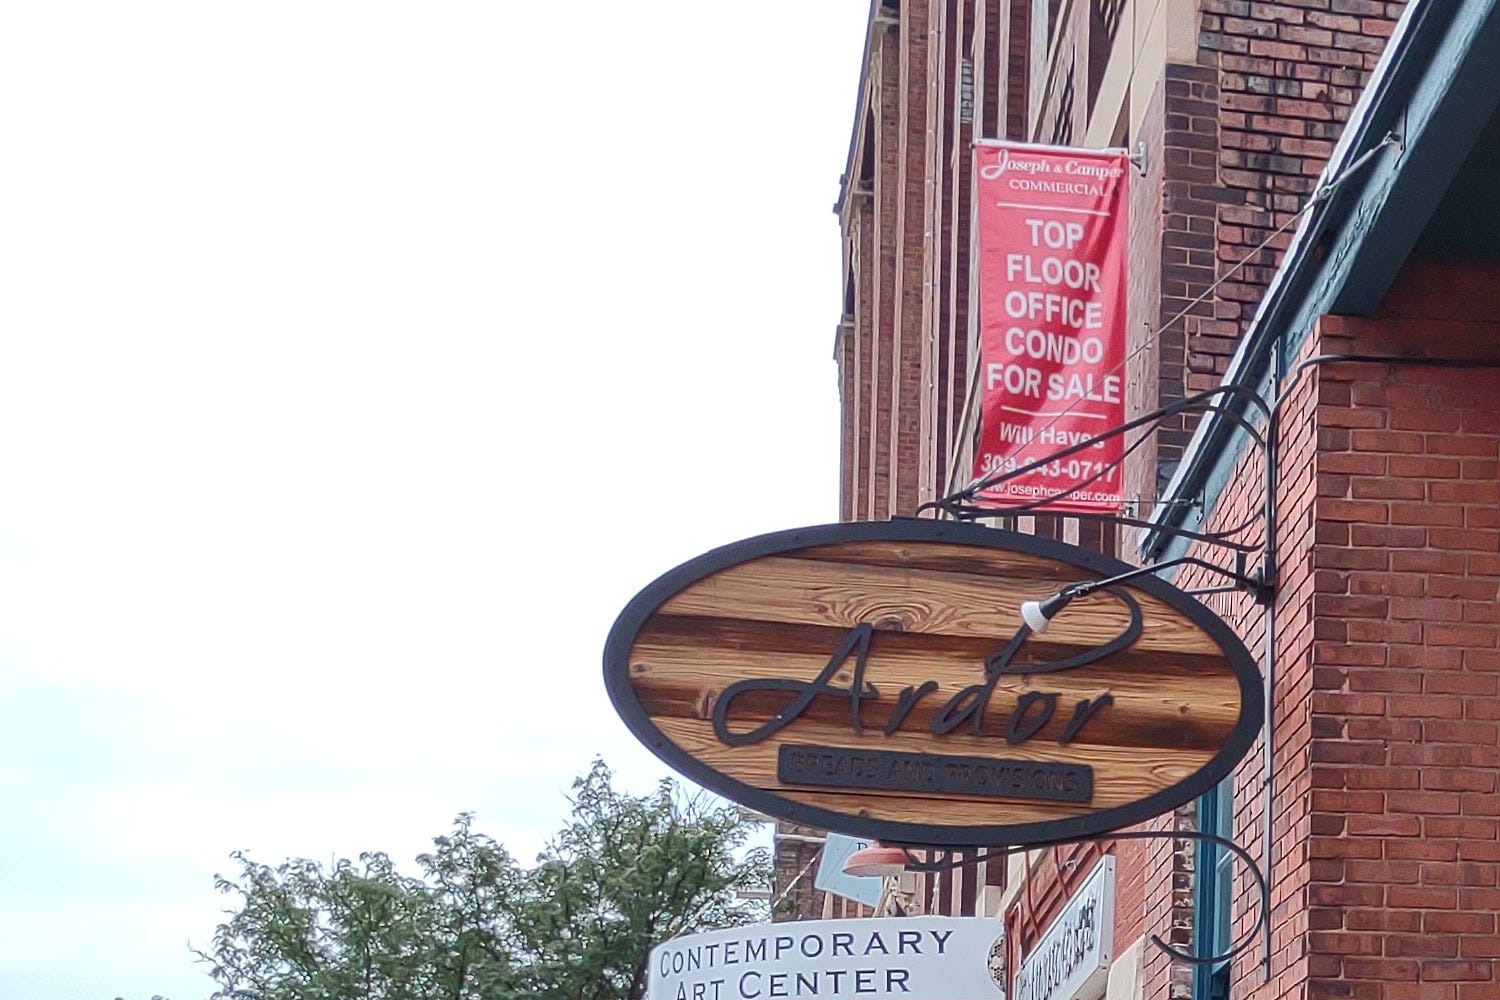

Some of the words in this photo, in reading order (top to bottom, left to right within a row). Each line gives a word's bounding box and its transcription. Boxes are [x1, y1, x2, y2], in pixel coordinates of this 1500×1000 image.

[981, 149, 1049, 179] Joseph
[1053, 164, 1063, 174] &
[1065, 161, 1124, 179] Camper
[1009, 179, 1108, 197] COMMERCIAL
[1026, 218, 1084, 250] TOP
[1007, 253, 1101, 293] FLOOR
[1005, 291, 1102, 329] OFFICE
[1005, 327, 1103, 366] CONDO
[986, 363, 1042, 398] FOR
[1046, 373, 1121, 404] SALE
[1000, 422, 1034, 445] Will
[712, 584, 1143, 745] Ardor
[790, 752, 880, 778] BREADS
[889, 758, 933, 784] AND
[944, 763, 1079, 793] PROVISIONS
[660, 930, 953, 978] CONTEMPORARY
[739, 968, 912, 1000] CENTER
